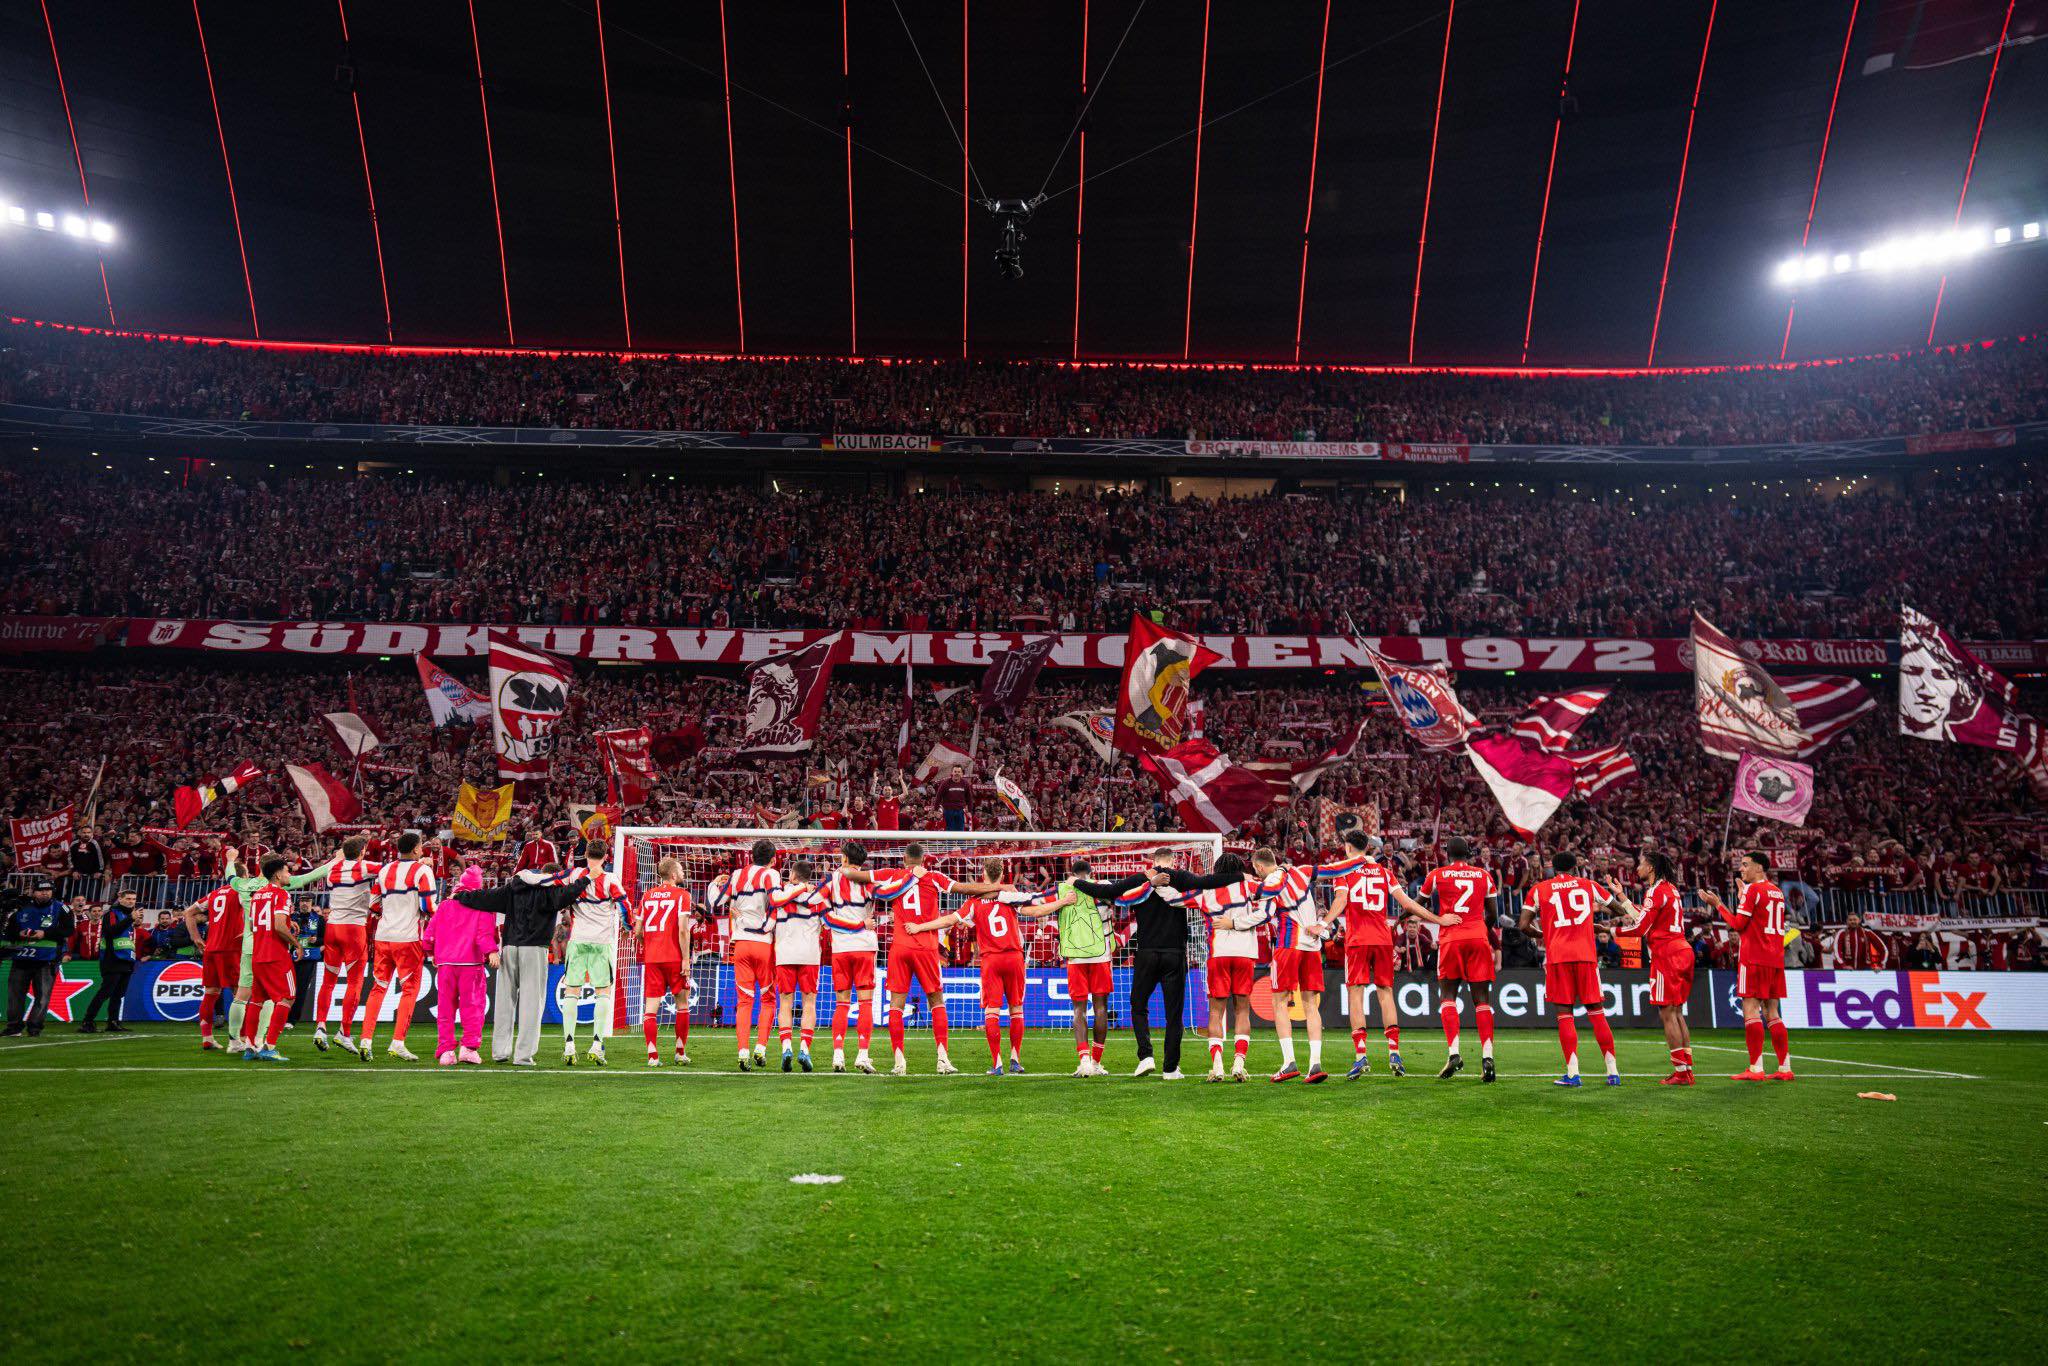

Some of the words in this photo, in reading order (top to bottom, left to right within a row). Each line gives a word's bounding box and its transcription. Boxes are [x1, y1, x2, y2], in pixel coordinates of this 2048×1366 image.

[835, 435, 929, 449] KULMBACH
[201, 622, 803, 663] SÜDKURVE
[1418, 637, 1656, 672] 1972
[1763, 641, 1808, 662] Red
[1811, 641, 1888, 664] United
[20, 813, 69, 837] ultras
[22, 839, 69, 864] sün
[1441, 870, 1483, 879] UPAMECANO
[1551, 880, 1579, 891] DAVIES
[213, 895, 227, 923] 9
[650, 891, 671, 899] LAIMER
[902, 884, 922, 916] 4
[1349, 877, 1385, 912] 45
[1453, 879, 1474, 913] 2
[1548, 888, 1592, 928] 19
[251, 900, 272, 932] 14
[644, 900, 676, 932] 27
[988, 904, 1009, 937] 6
[1764, 899, 1785, 936] 10
[156, 985, 204, 997] PEPS
[1803, 970, 1993, 1029] FedEx
